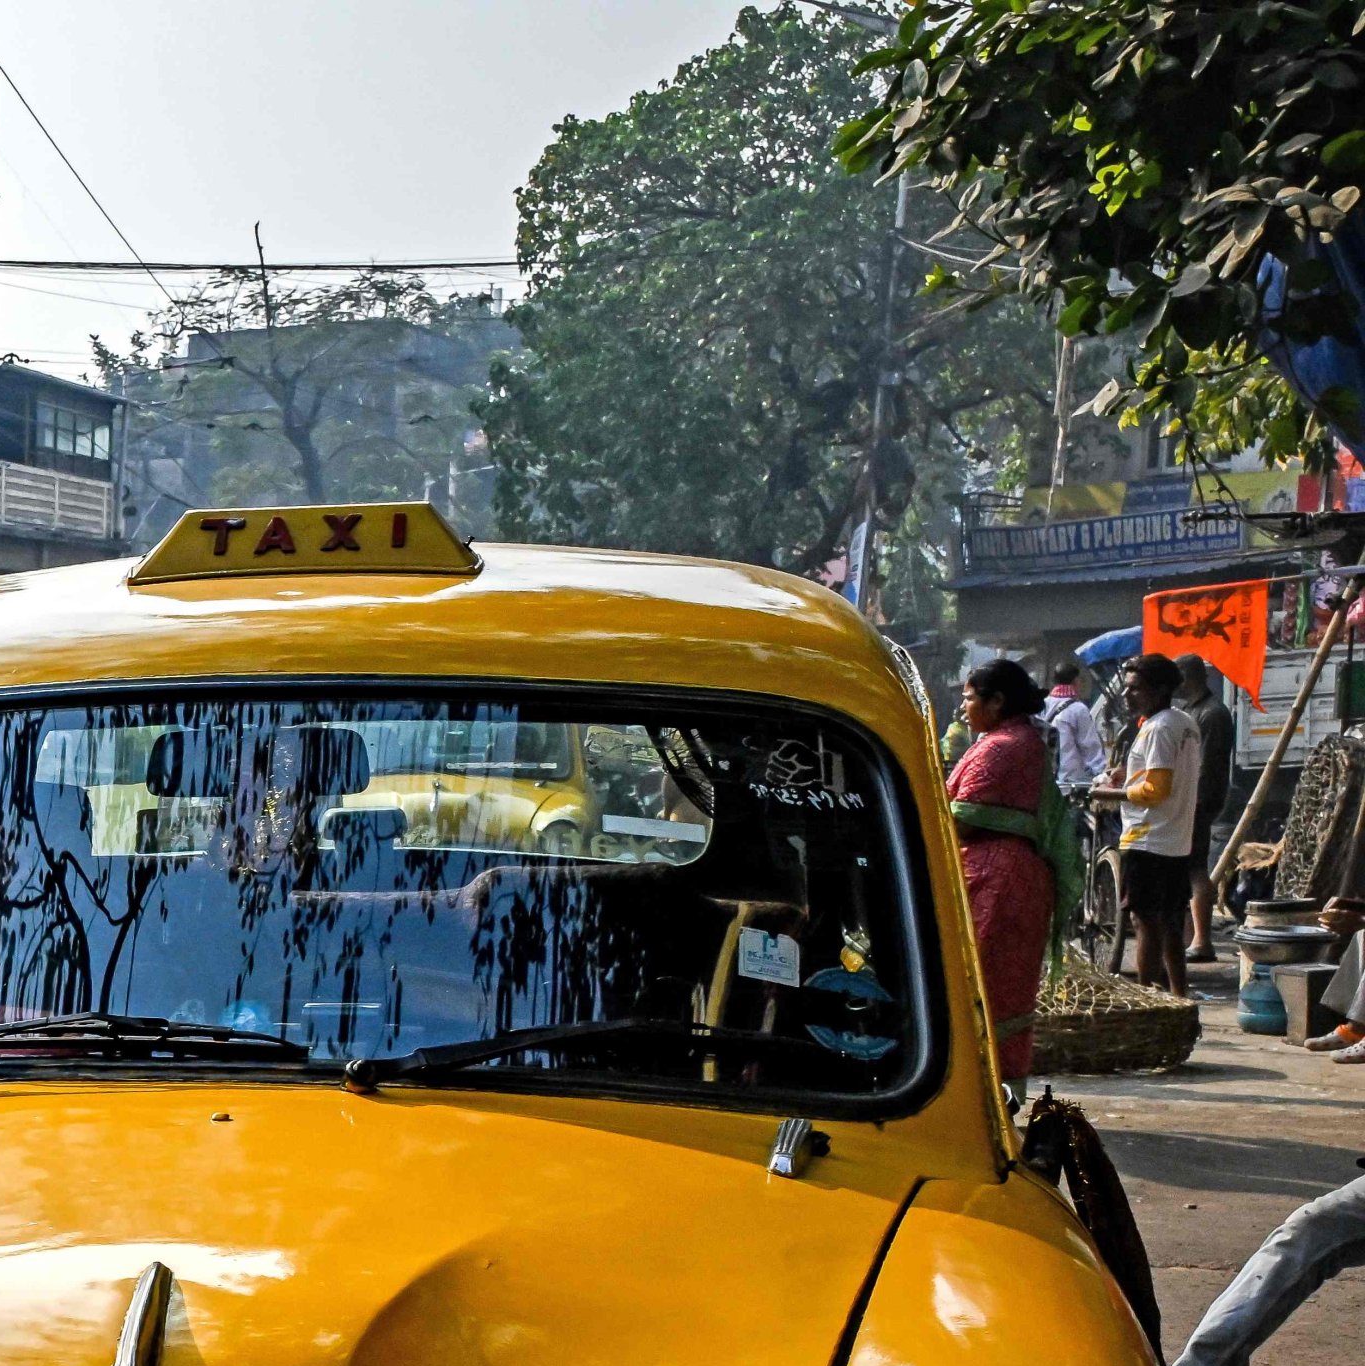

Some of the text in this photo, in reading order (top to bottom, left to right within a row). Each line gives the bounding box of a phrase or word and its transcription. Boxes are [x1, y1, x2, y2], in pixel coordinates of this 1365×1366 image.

[200, 513, 408, 556] TAXI
[1010, 524, 1078, 554] SANITARY
[1092, 513, 1172, 548] PLUMBING
